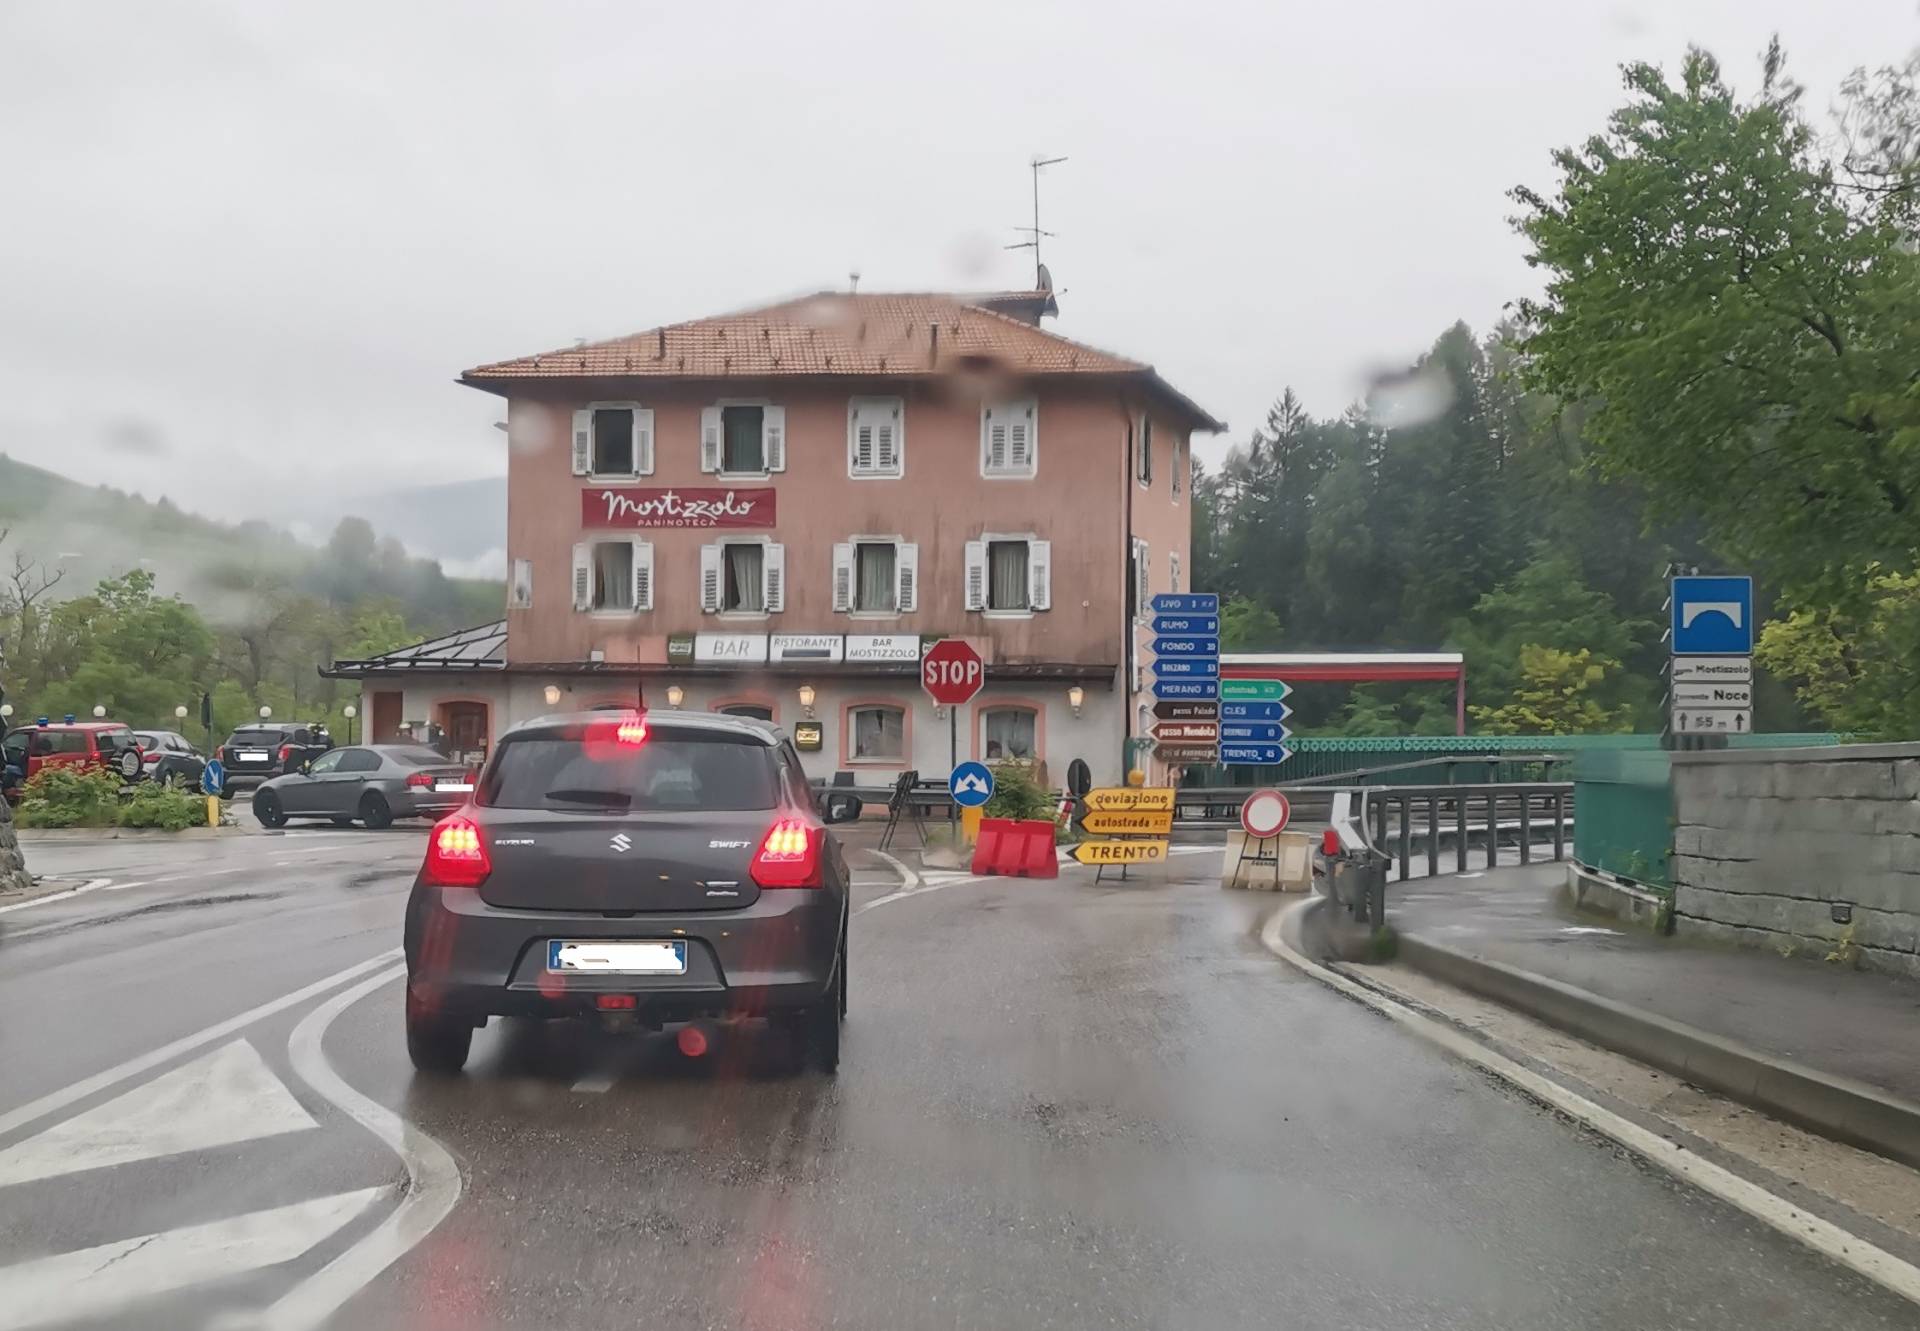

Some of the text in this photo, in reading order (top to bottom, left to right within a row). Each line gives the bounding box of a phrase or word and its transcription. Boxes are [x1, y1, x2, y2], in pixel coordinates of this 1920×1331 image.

[601, 489, 757, 521] Mostizzolo
[637, 518, 717, 527] PANINOTECA
[1160, 599, 1182, 609] LIVO
[1161, 620, 1189, 630] RUMO
[773, 637, 840, 649] RISTORANTE
[871, 638, 893, 648] BAR
[1161, 642, 1195, 651] FONDO
[712, 640, 751, 657] BAR
[848, 648, 918, 658] MOSTIZZOLO
[925, 660, 980, 686] STOP
[1161, 685, 1202, 693] MERANO
[1713, 689, 1750, 701] Noce
[1223, 706, 1247, 715] CLES
[1159, 726, 1216, 739] passo Mendola
[1222, 749, 1259, 758] TRENTO
[1095, 791, 1169, 805] deviazione
[1093, 815, 1151, 828] autostrada
[708, 840, 752, 849] SWIFT
[1090, 845, 1160, 859] TRENTO
